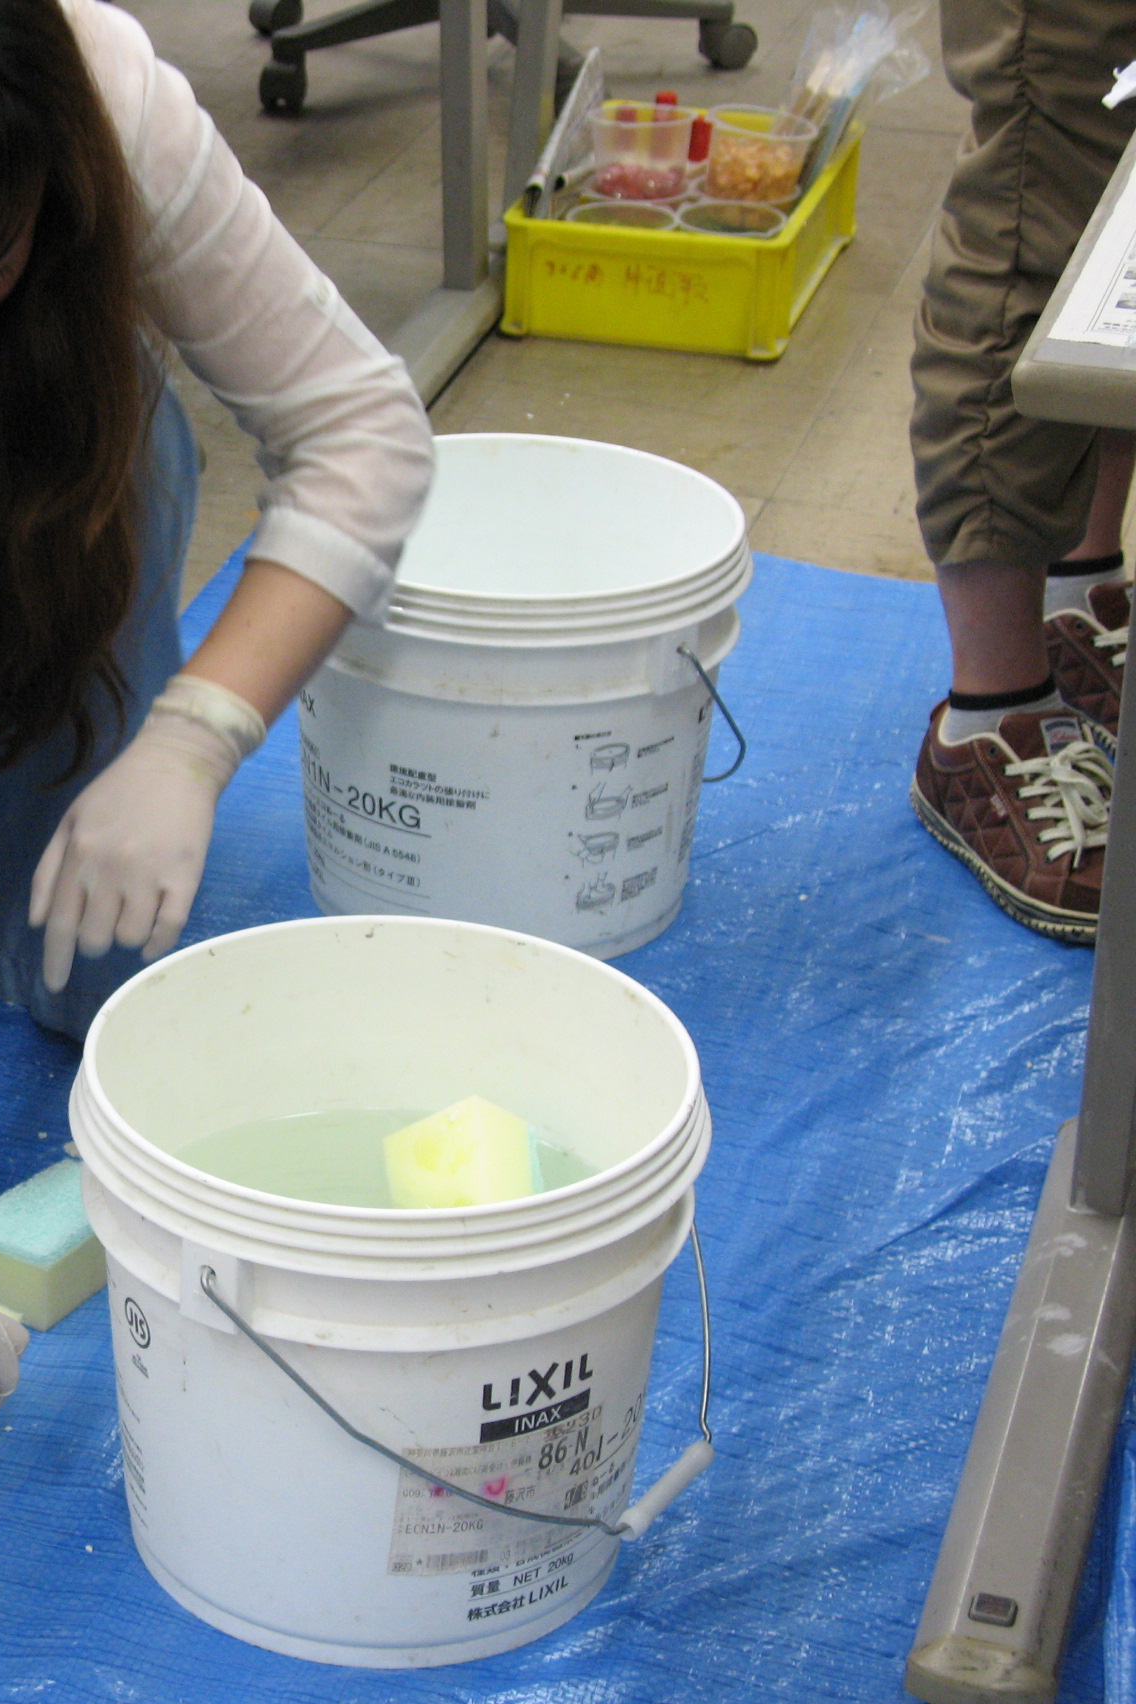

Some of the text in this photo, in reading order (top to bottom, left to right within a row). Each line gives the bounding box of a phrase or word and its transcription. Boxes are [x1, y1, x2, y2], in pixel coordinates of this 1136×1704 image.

[483, 1353, 592, 1411] LIXIL
[514, 1405, 562, 1433] INAX
[470, 1553, 574, 1598] 質量 NET 20kg
